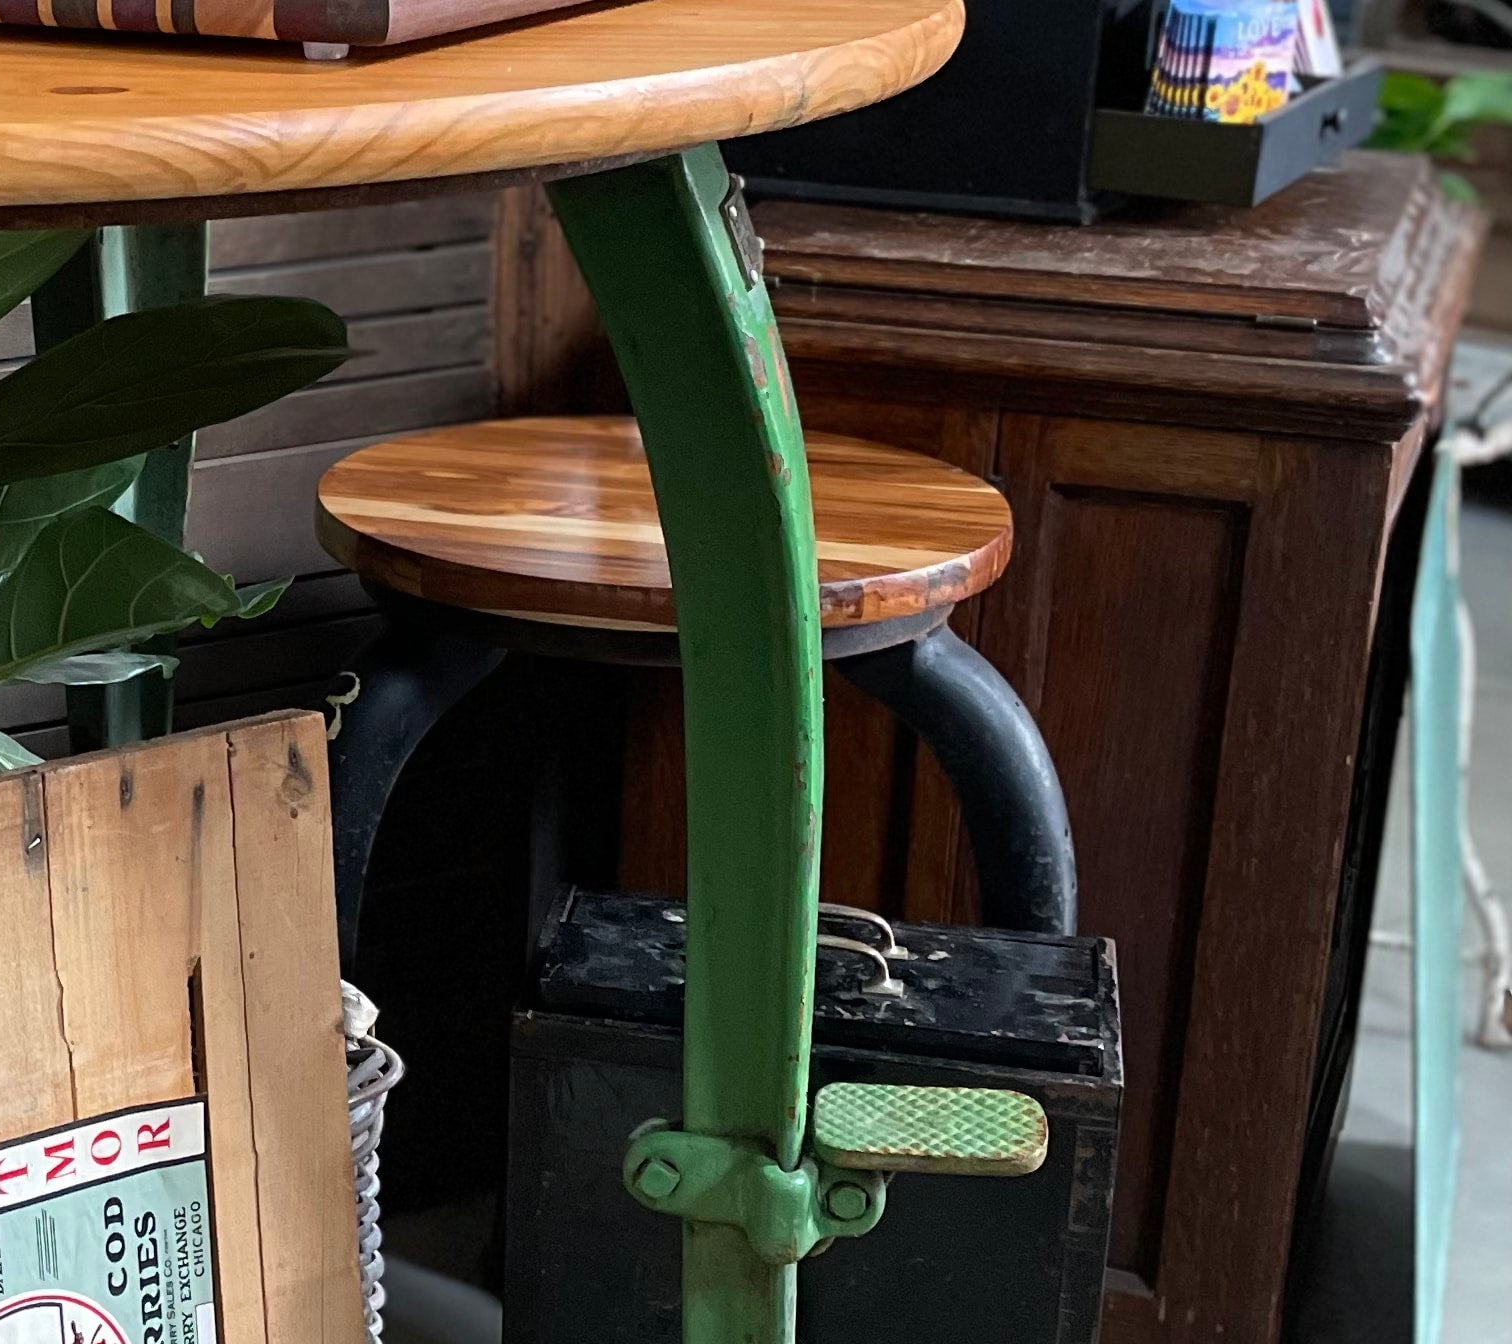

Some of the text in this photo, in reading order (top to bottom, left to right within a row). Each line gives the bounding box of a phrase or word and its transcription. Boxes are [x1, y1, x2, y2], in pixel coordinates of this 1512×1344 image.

[1237, 17, 1281, 42] LOVE
[103, 1196, 128, 1297] COD
[173, 1206, 192, 1303] EXCHANGE
[190, 1201, 205, 1278] CHICAGO
